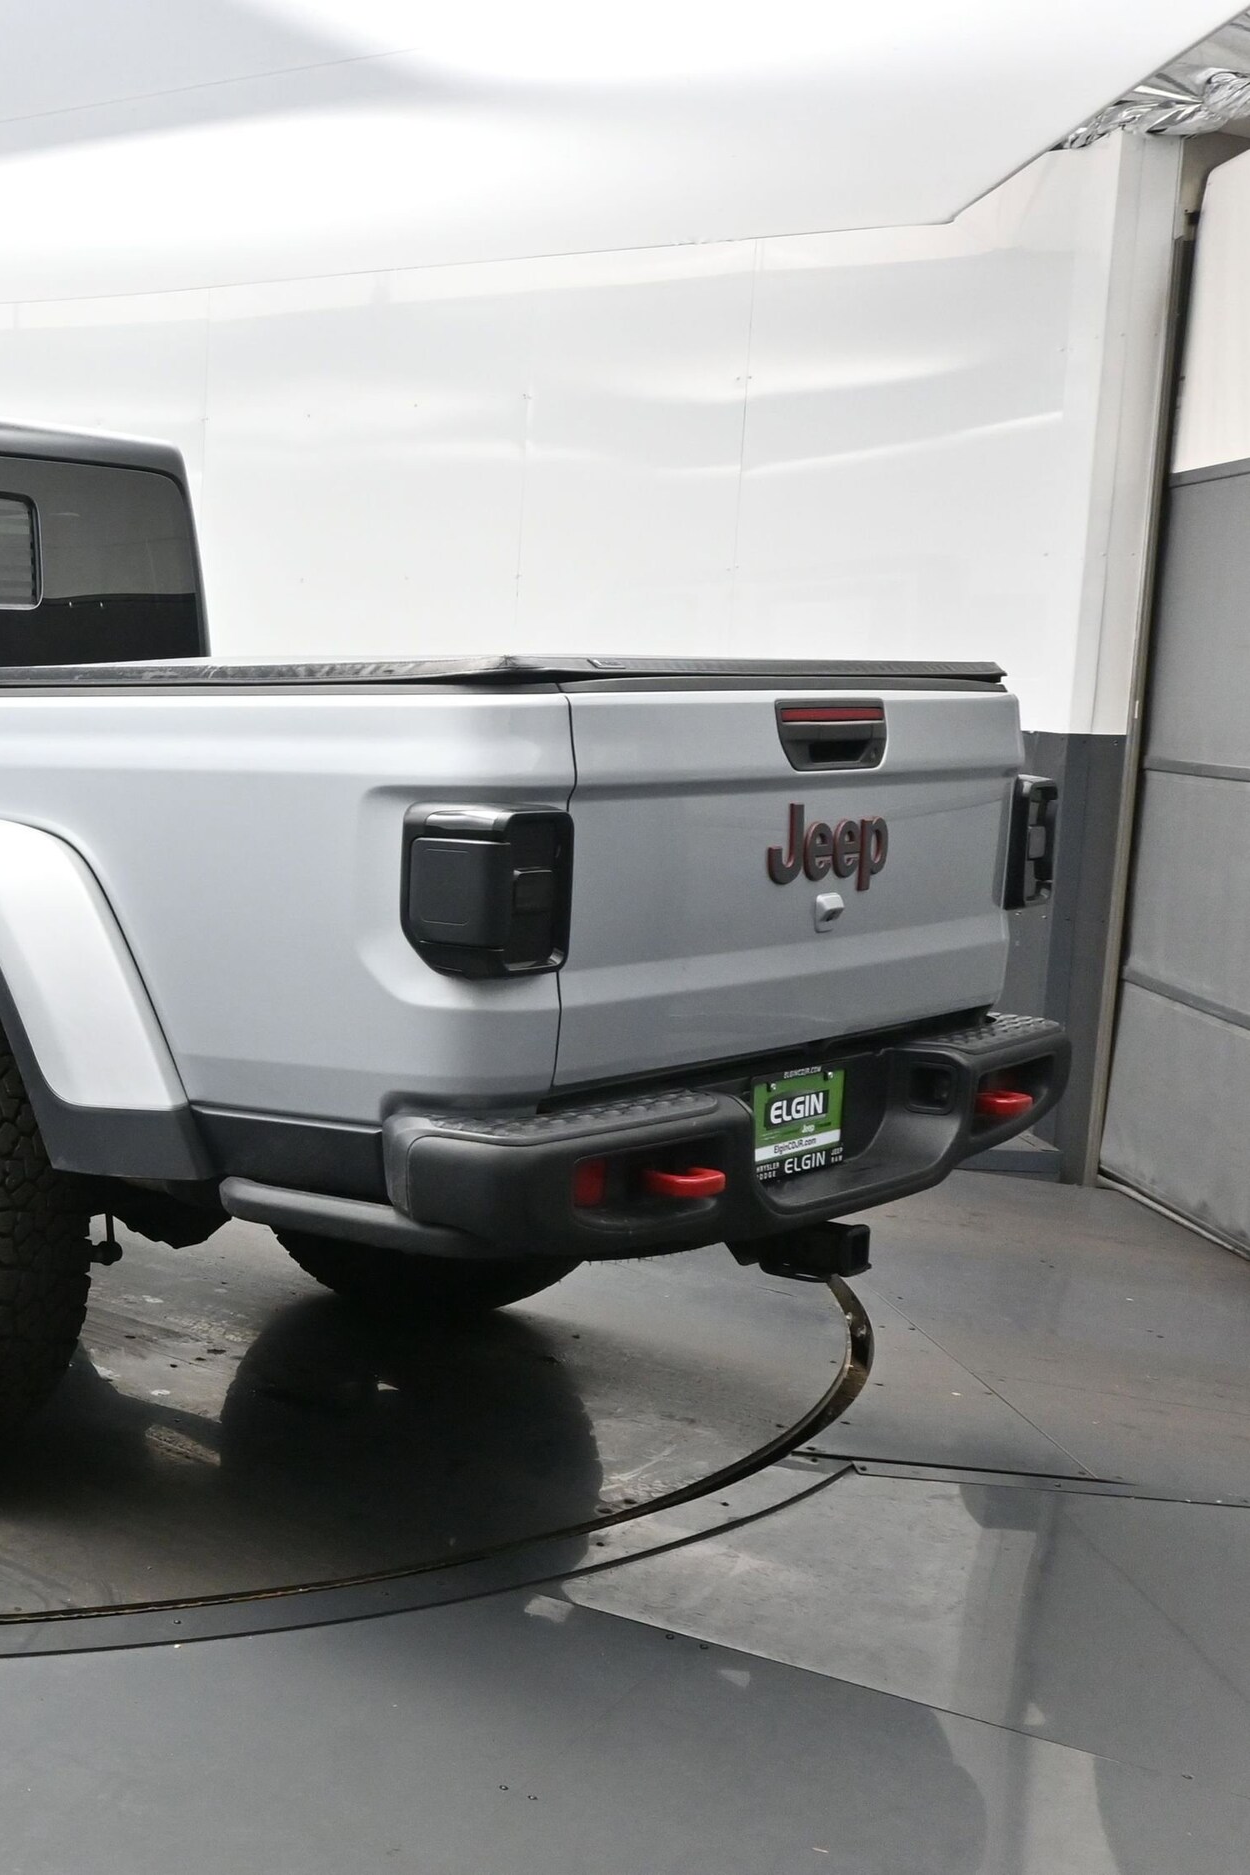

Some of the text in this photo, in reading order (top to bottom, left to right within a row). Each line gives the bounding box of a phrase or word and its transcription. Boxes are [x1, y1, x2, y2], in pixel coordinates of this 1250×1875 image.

[767, 802, 889, 891] Jeep
[770, 1092, 824, 1125] ELGIN
[801, 1124, 815, 1134] Jeep
[773, 1137, 817, 1155] ElginCDJR.com
[784, 1150, 826, 1174] ELGIN
